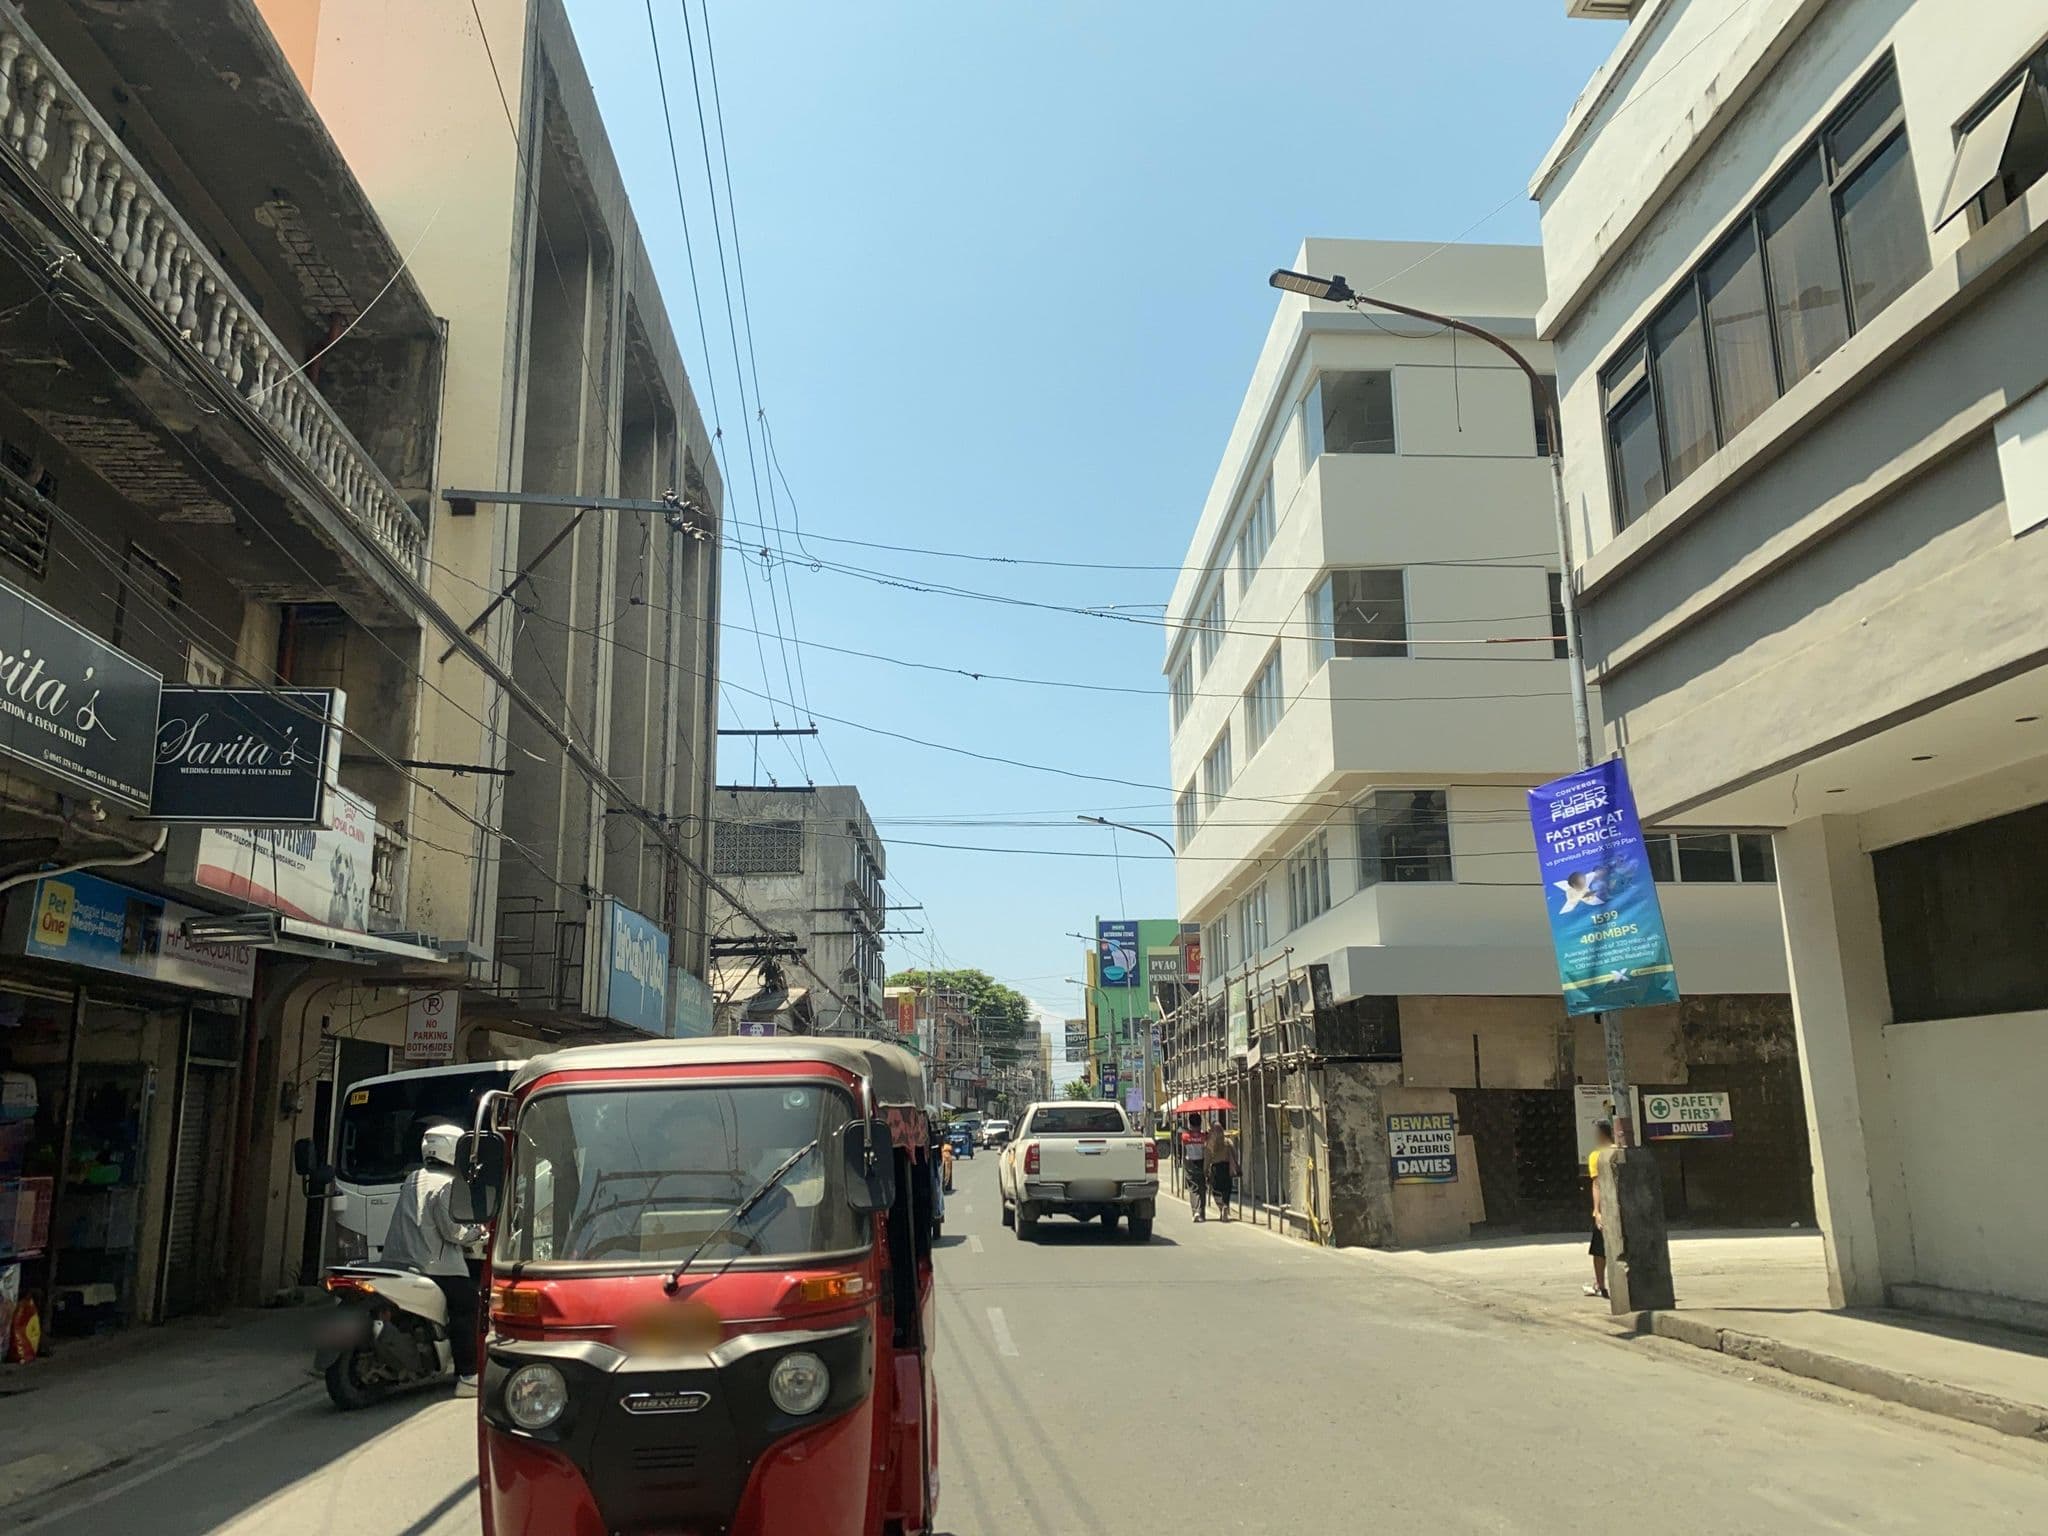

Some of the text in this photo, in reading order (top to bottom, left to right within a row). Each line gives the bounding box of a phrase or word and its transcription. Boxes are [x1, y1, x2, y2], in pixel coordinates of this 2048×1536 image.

[26, 712, 33, 724] &
[34, 715, 58, 735] EVENT
[59, 727, 87, 748] STYLIST
[180, 767, 210, 775] WEDDING
[1556, 779, 1597, 797] CONVERGE
[1550, 785, 1608, 811] SUPER
[1545, 809, 1624, 843] FASTEST AT
[1554, 825, 1622, 854] ITS PRICE.
[1554, 851, 1582, 866] previous
[1620, 836, 1637, 846] Plan
[48, 892, 67, 915] Pet
[42, 911, 65, 934] One
[1591, 910, 1618, 925] 1599
[1580, 923, 1639, 945] 400MBPS
[1151, 961, 1177, 971] PVAO
[426, 1019, 438, 1028] NO
[413, 1031, 448, 1040] PARKING
[1680, 1107, 1719, 1120] FIRST
[1390, 1114, 1451, 1130] BEWARE
[1672, 1122, 1709, 1133] DAVIES
[1406, 1133, 1452, 1143] FALLING
[1410, 1144, 1450, 1154] DEBRIS
[1397, 1158, 1451, 1174] DAVIES
